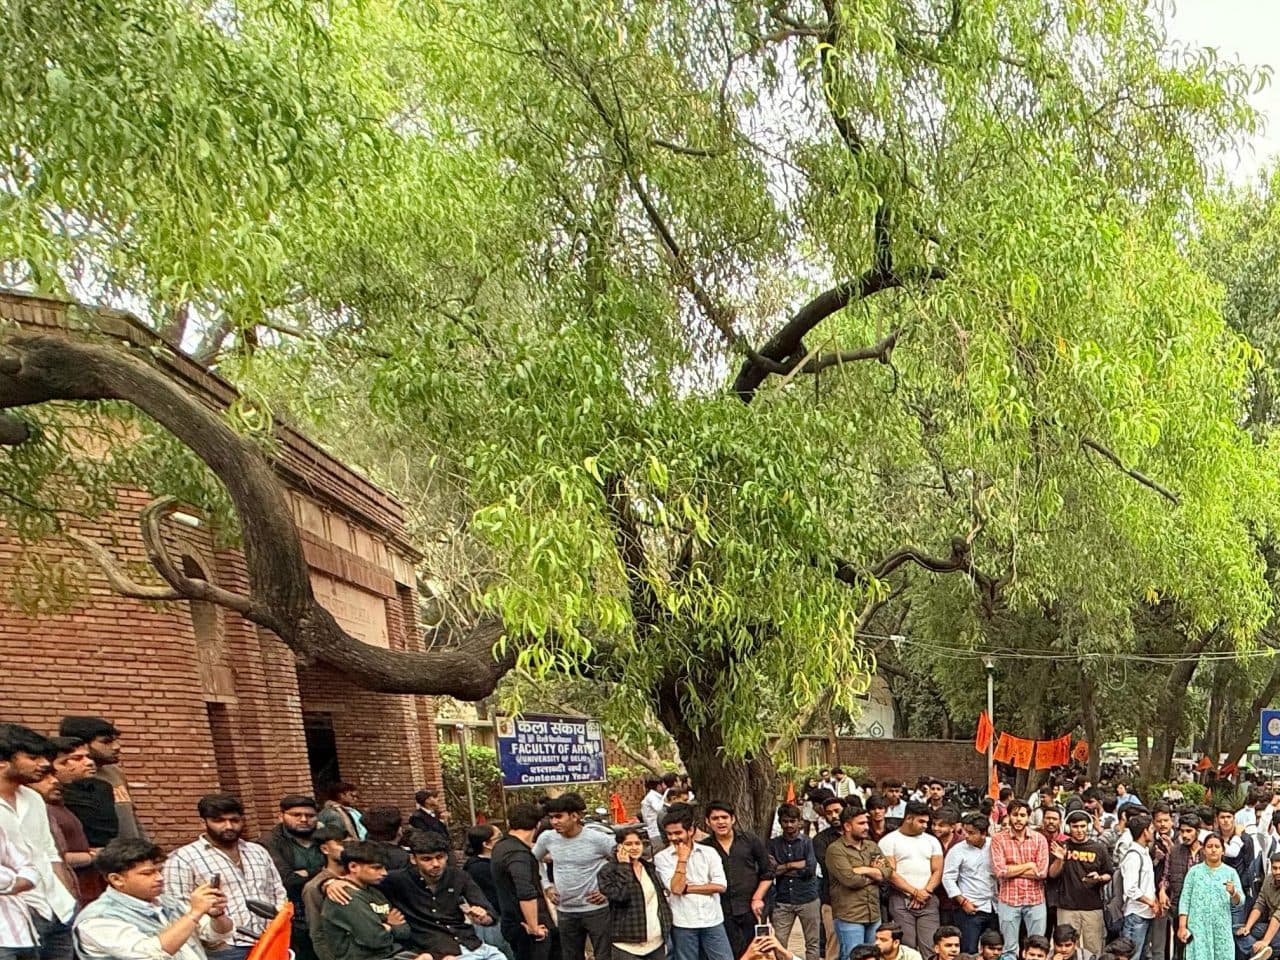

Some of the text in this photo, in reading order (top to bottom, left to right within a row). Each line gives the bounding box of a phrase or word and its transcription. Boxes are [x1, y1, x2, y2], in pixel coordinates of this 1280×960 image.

[516, 719, 586, 735] कला संकाय
[511, 742, 556, 754] FACULTY
[558, 743, 570, 754] OF
[522, 774, 570, 783] Centenary
